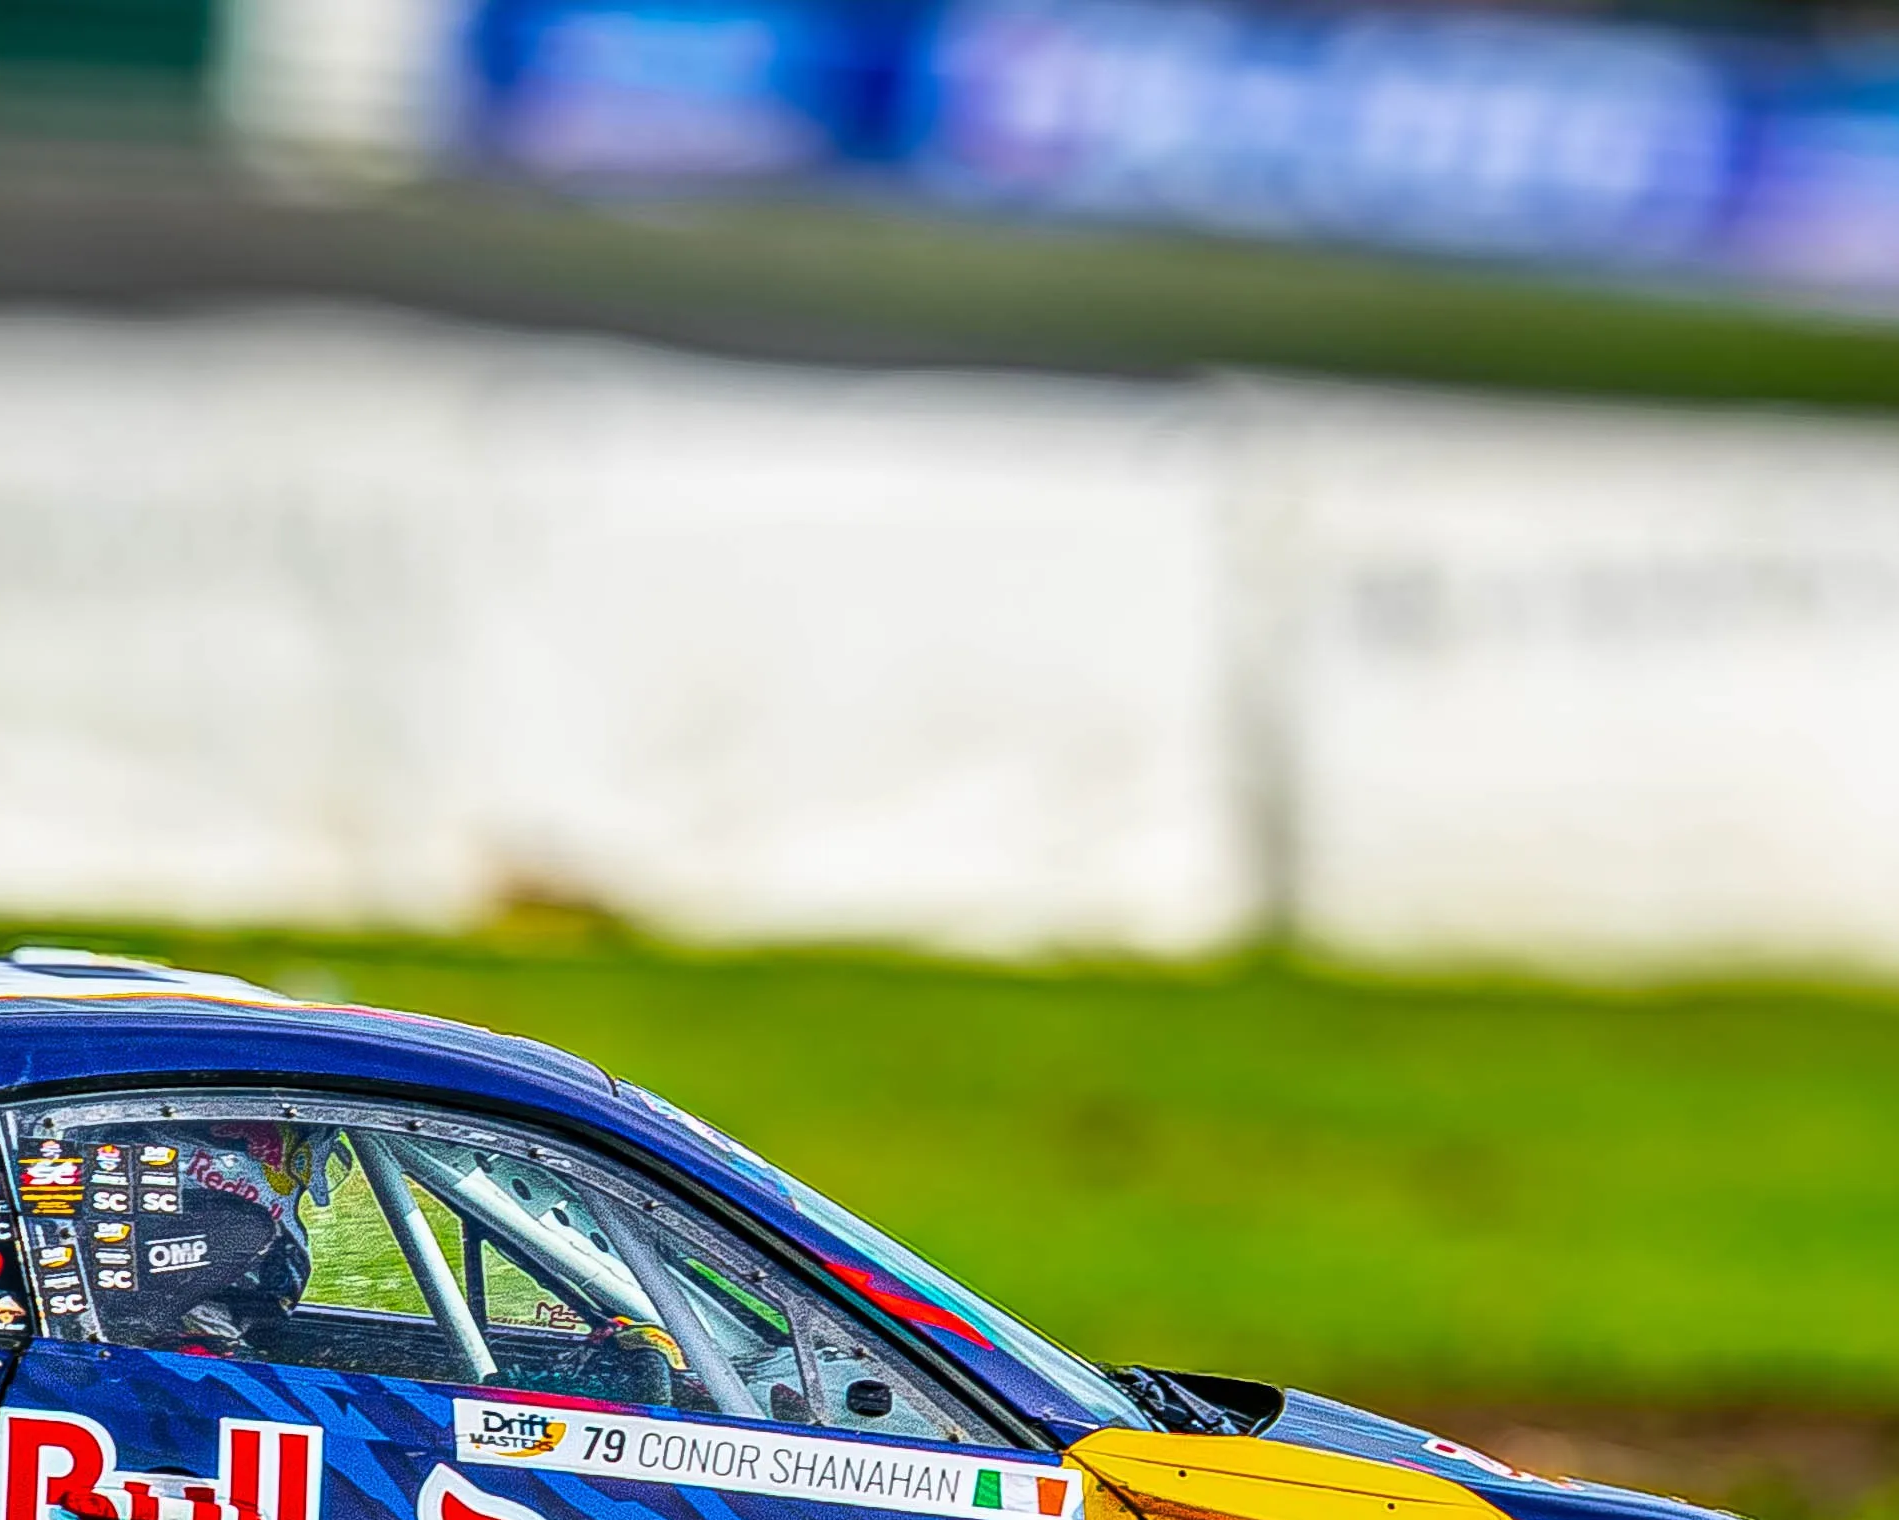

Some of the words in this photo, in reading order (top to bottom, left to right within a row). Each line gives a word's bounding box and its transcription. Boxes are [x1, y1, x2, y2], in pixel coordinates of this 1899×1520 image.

[93, 1191, 128, 1212] SC
[142, 1192, 178, 1212] SC
[149, 1241, 208, 1268] OMP
[97, 1270, 132, 1289] SC
[49, 1294, 84, 1314] SC
[482, 1409, 553, 1439] Drift
[469, 1432, 555, 1452] MASTERS
[582, 1427, 626, 1464] 79
[638, 1432, 761, 1480] CONOR
[770, 1448, 963, 1504] SHANAHAN
